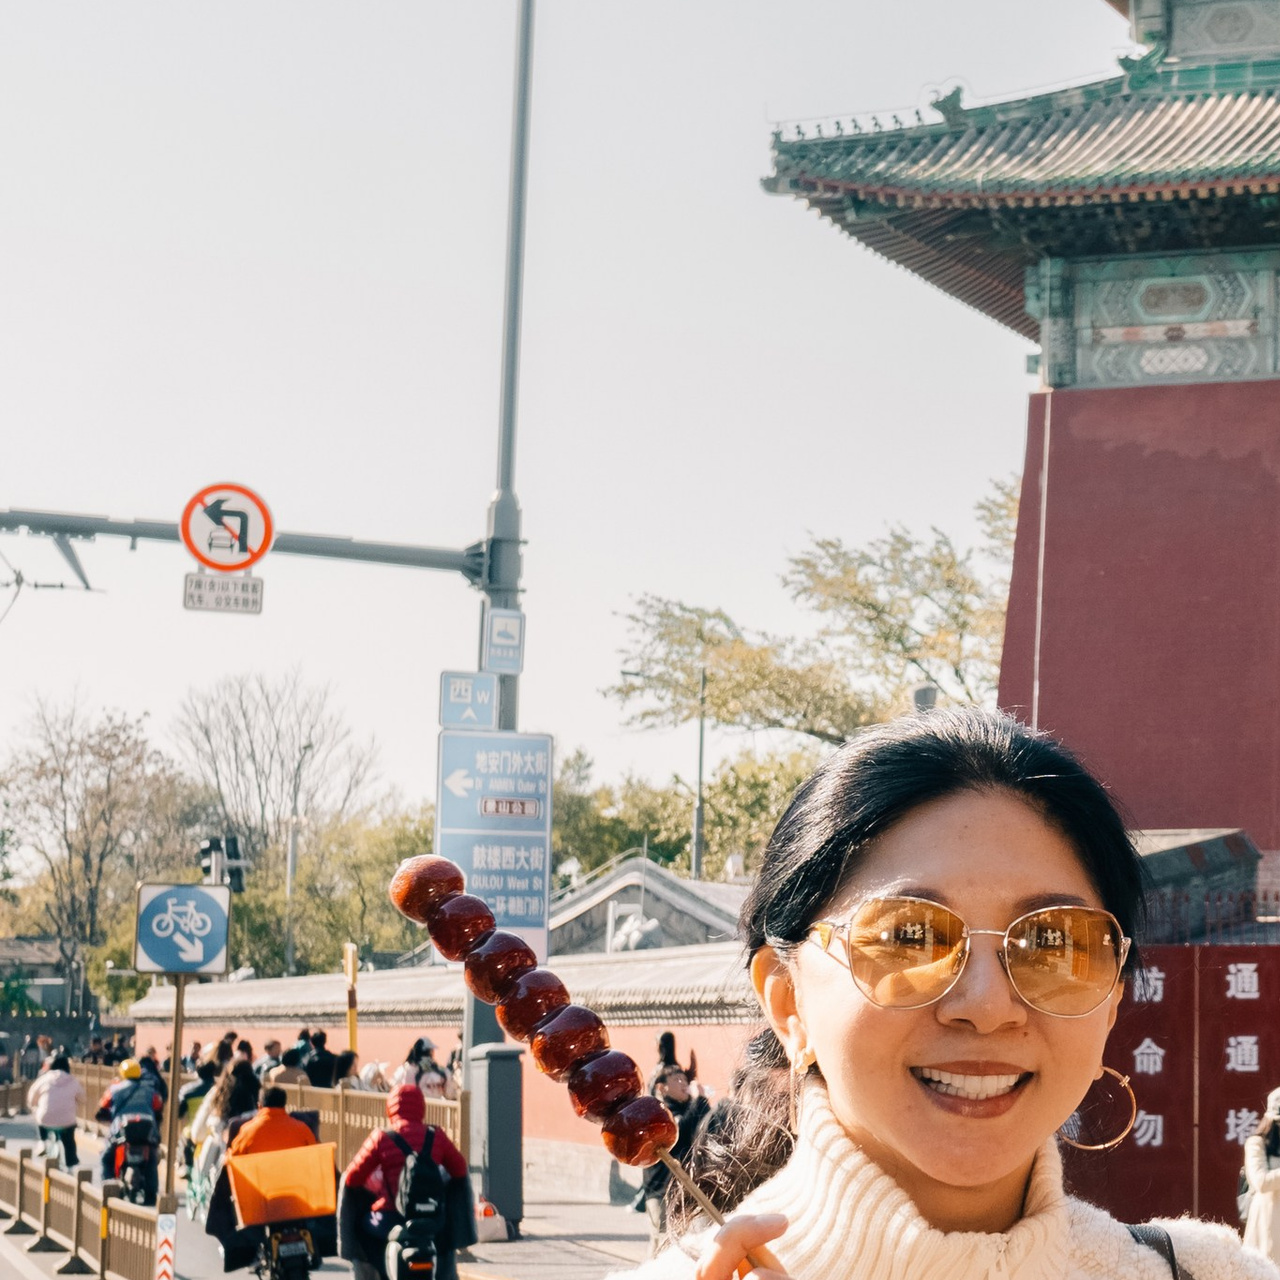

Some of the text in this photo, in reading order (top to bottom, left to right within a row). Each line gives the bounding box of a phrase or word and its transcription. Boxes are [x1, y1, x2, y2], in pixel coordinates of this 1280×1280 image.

[449, 678, 490, 705] 西 W
[475, 749, 547, 775] 地安门外大街
[472, 845, 544, 871] 鼓楼西大街
[471, 874, 543, 891] GULOU West St
